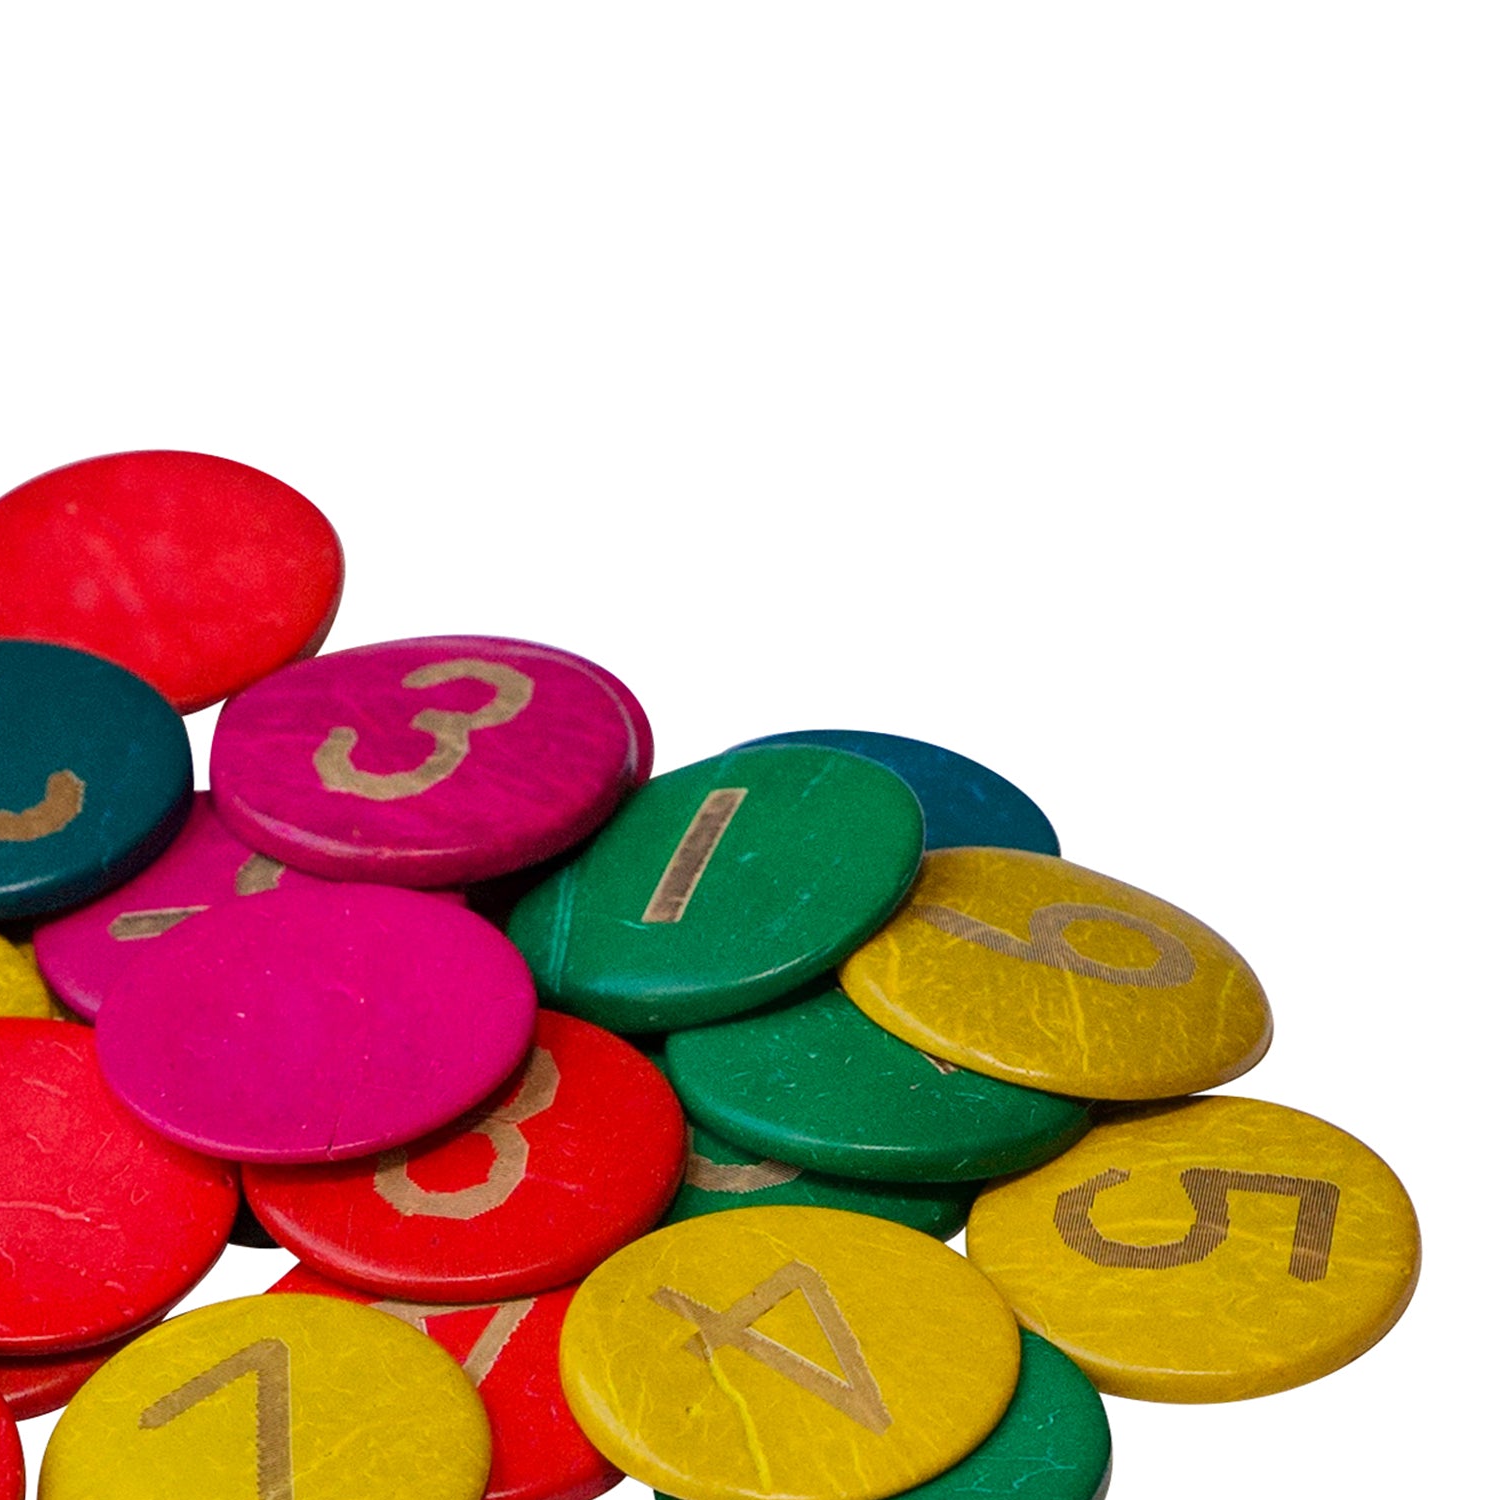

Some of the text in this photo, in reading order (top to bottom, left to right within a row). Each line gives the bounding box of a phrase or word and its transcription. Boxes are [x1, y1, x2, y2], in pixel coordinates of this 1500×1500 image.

[312, 659, 535, 801] 3
[641, 787, 748, 923] 1
[1053, 1167, 1341, 1283] 5
[647, 1258, 893, 1436] 4
